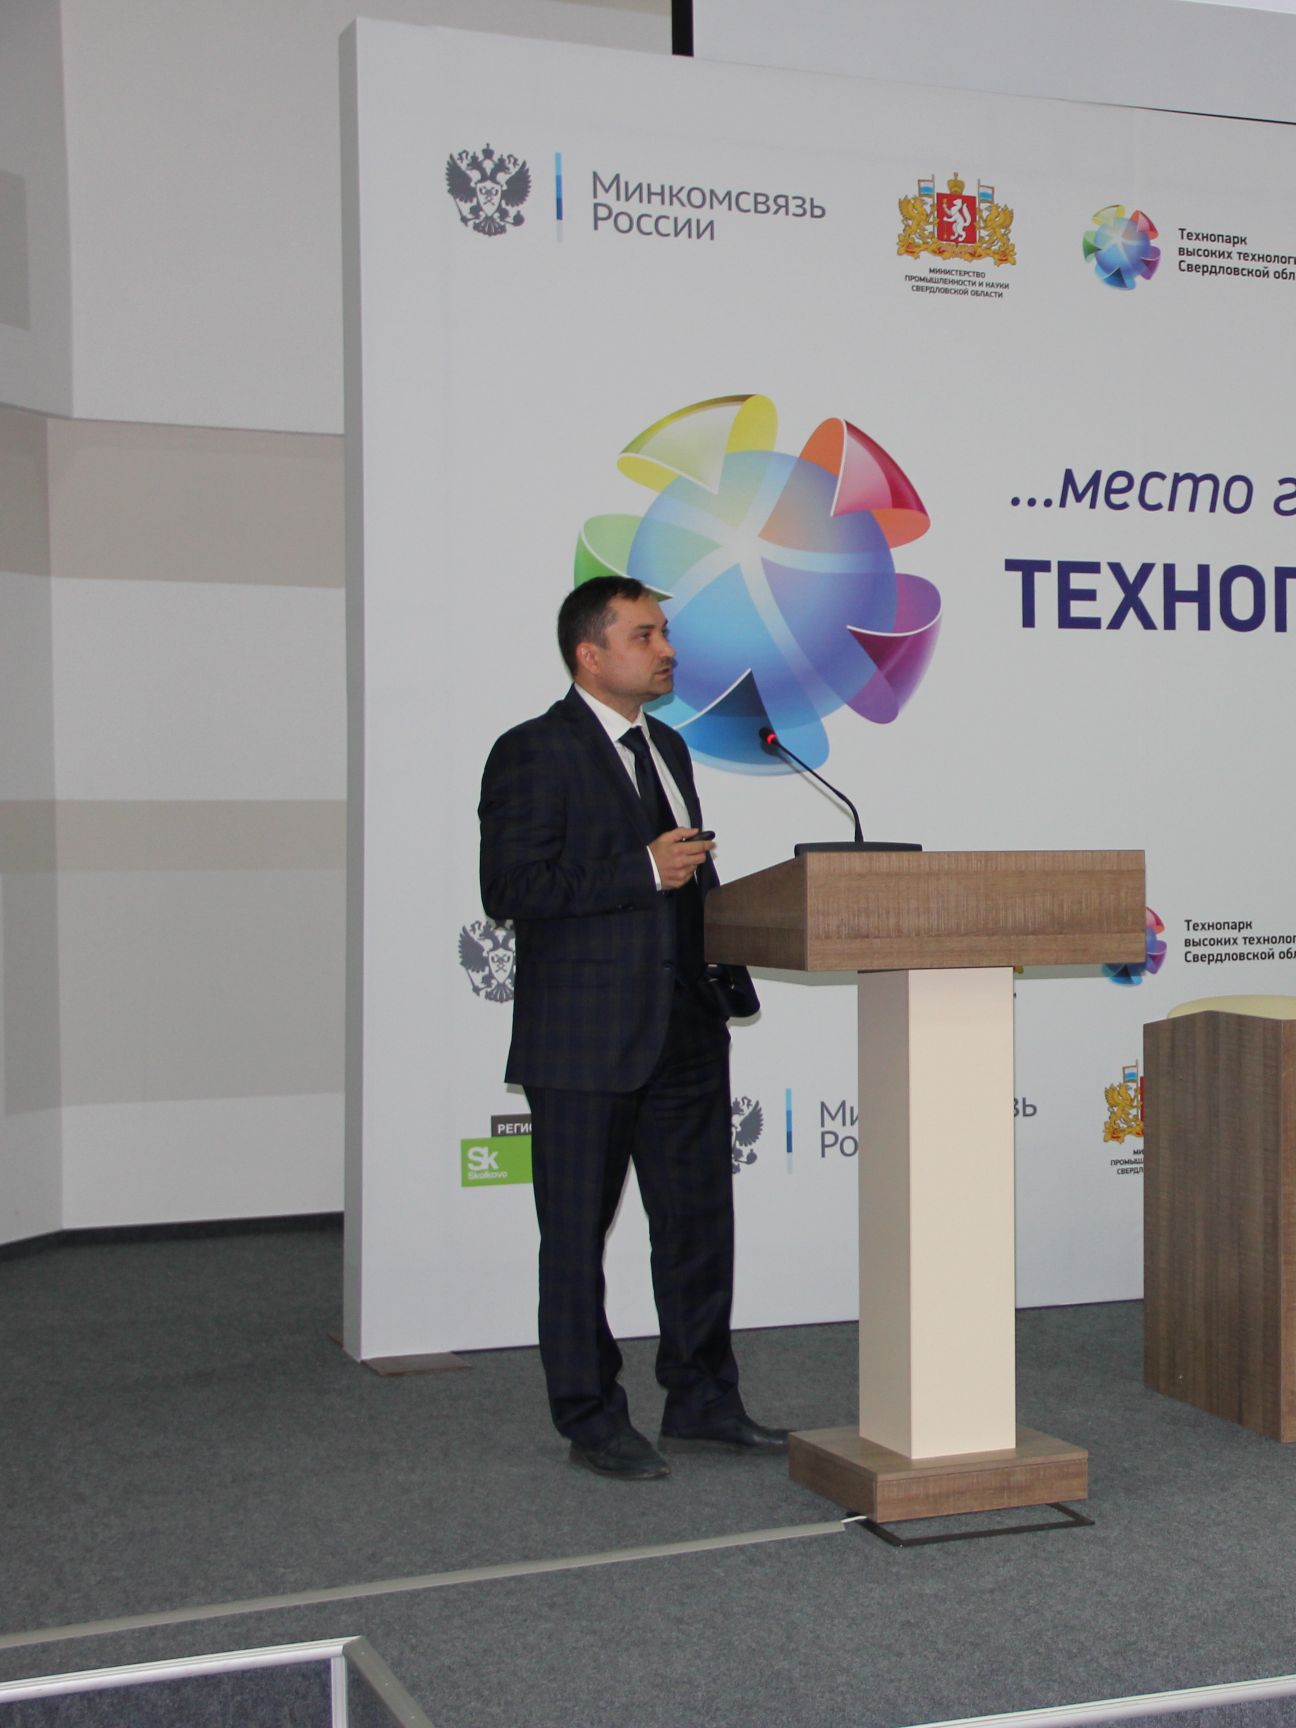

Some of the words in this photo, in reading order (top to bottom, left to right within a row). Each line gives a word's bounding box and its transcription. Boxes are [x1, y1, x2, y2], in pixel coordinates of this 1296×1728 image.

[1178, 228, 1248, 246] Технопарк
[1178, 246, 1233, 260] высоких
[929, 267, 986, 278] МИНИСТЕРСТВО
[1178, 260, 1270, 279] Свердловской
[905, 275, 977, 287] ПРОМЫШЛЕННОСТИ
[911, 285, 969, 296] СВЕРДЛОВСКОЙ
[970, 289, 1003, 298] ОБЛАСТИ
[1184, 919, 1253, 933] Технопарк
[1184, 936, 1239, 947] высоких
[1184, 948, 1275, 965] Свердловской
[467, 1146, 499, 1171] Sk
